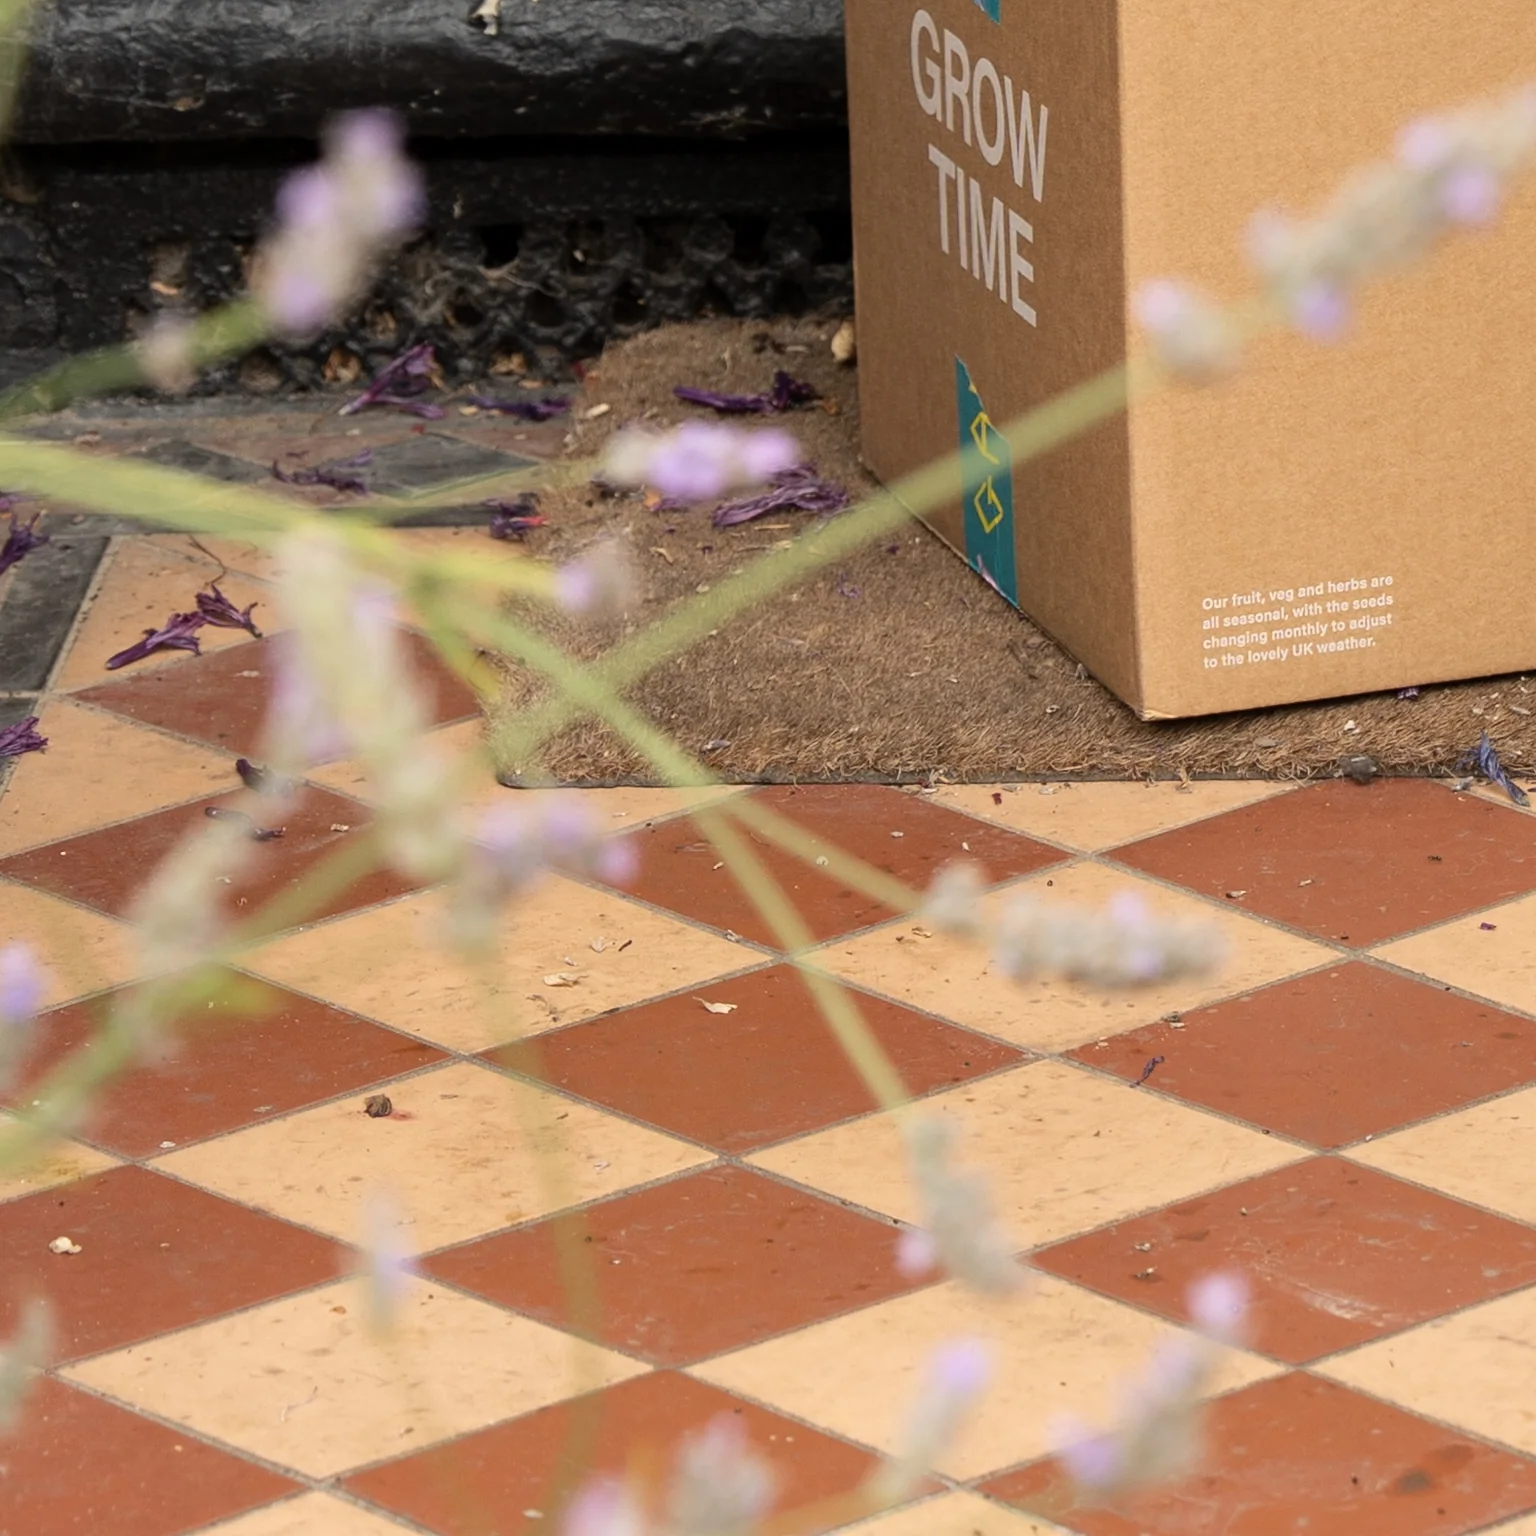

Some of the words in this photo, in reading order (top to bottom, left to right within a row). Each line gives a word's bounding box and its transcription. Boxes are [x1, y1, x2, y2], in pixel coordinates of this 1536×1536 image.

[911, 8, 1049, 203] GROW
[928, 143, 1037, 327] TIME
[1202, 597, 1228, 610] Our
[1231, 591, 1266, 607] fruit,
[1269, 588, 1294, 602] veg
[1297, 582, 1324, 597] and
[1328, 578, 1367, 594] herbs
[1371, 575, 1394, 588] are
[1203, 616, 1219, 630] all
[1223, 607, 1289, 627] seasonal,
[1292, 603, 1323, 617] with
[1326, 599, 1349, 613] the
[1352, 593, 1394, 610] seeds
[1203, 631, 1268, 649] changing
[1271, 621, 1328, 640] monthly
[1331, 619, 1345, 632] to
[1349, 613, 1392, 630] adjust
[1203, 656, 1218, 669] to
[1221, 653, 1244, 666] the
[1247, 646, 1289, 663] lovely
[1292, 643, 1314, 657] UK
[1316, 635, 1376, 654] weather.
